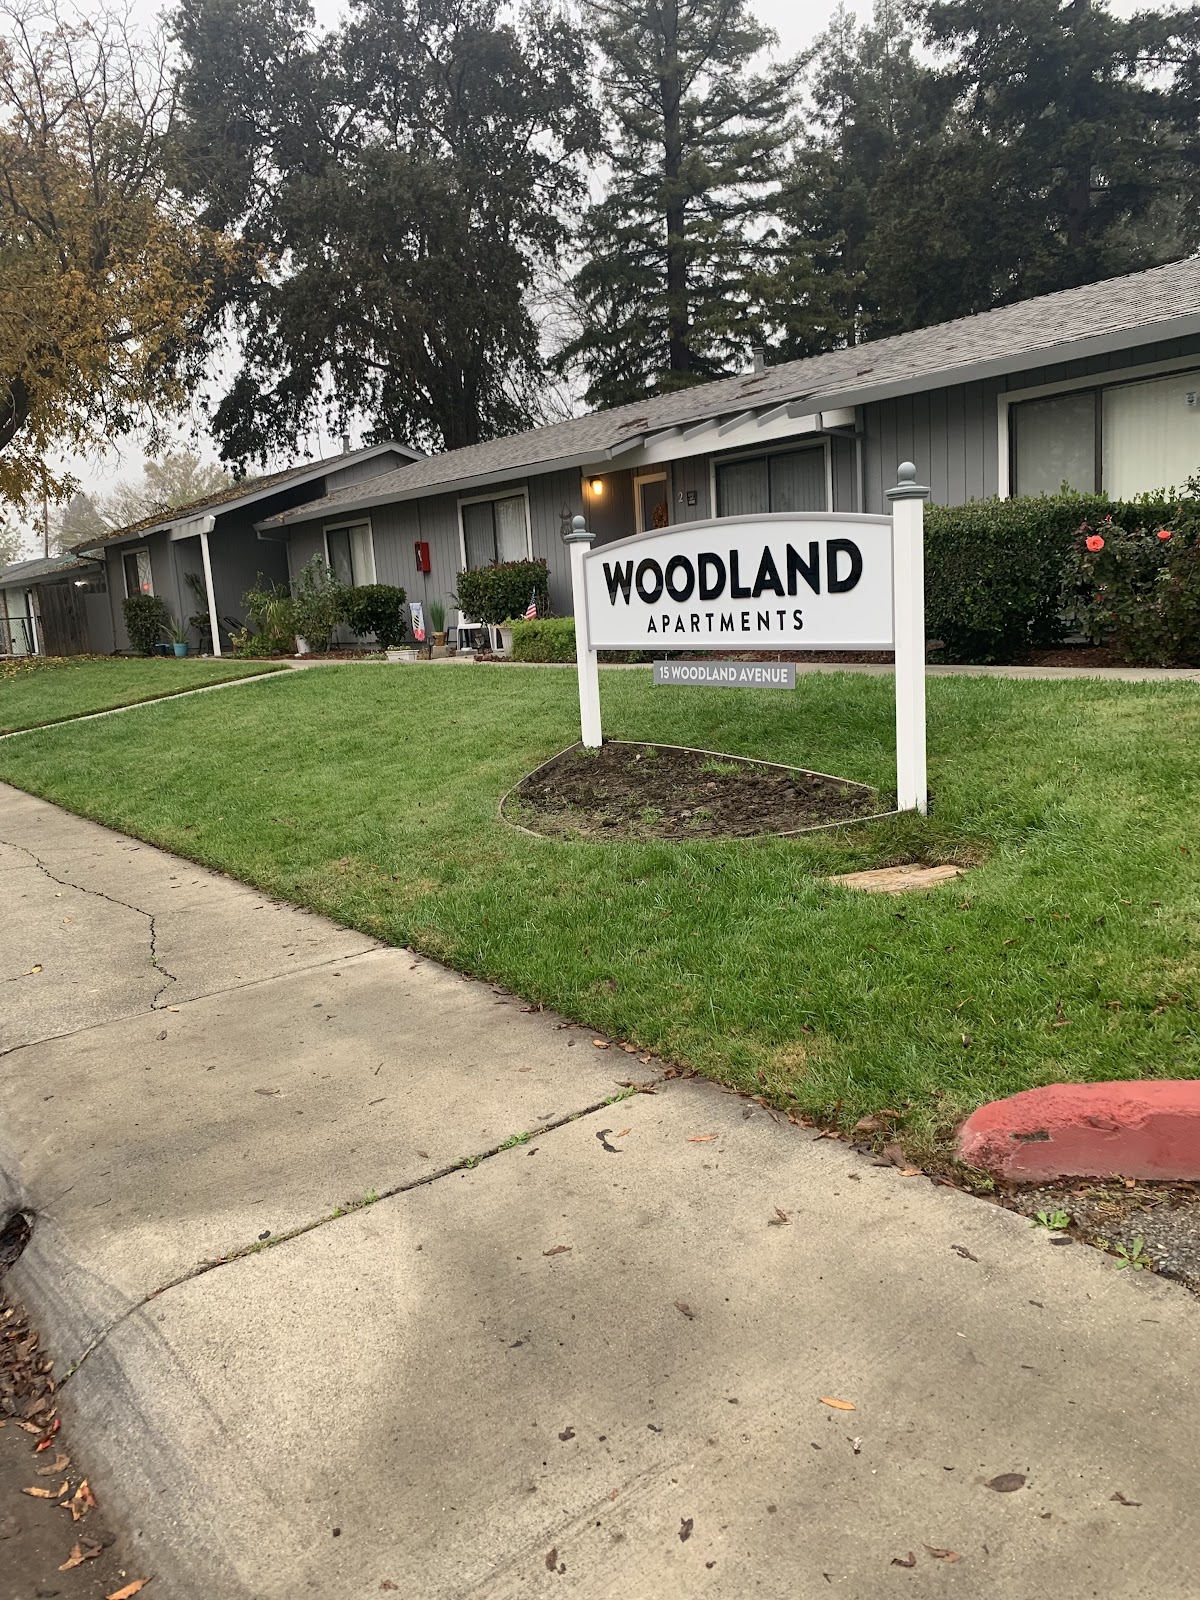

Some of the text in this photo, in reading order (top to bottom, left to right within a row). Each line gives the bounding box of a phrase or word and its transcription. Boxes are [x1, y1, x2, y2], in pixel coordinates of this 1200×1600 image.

[677, 491, 684, 503] 2
[602, 538, 863, 606] WOODLAND
[647, 609, 804, 633] APARTMENTS
[659, 666, 788, 683] 15 WOODLAND AVENUE
